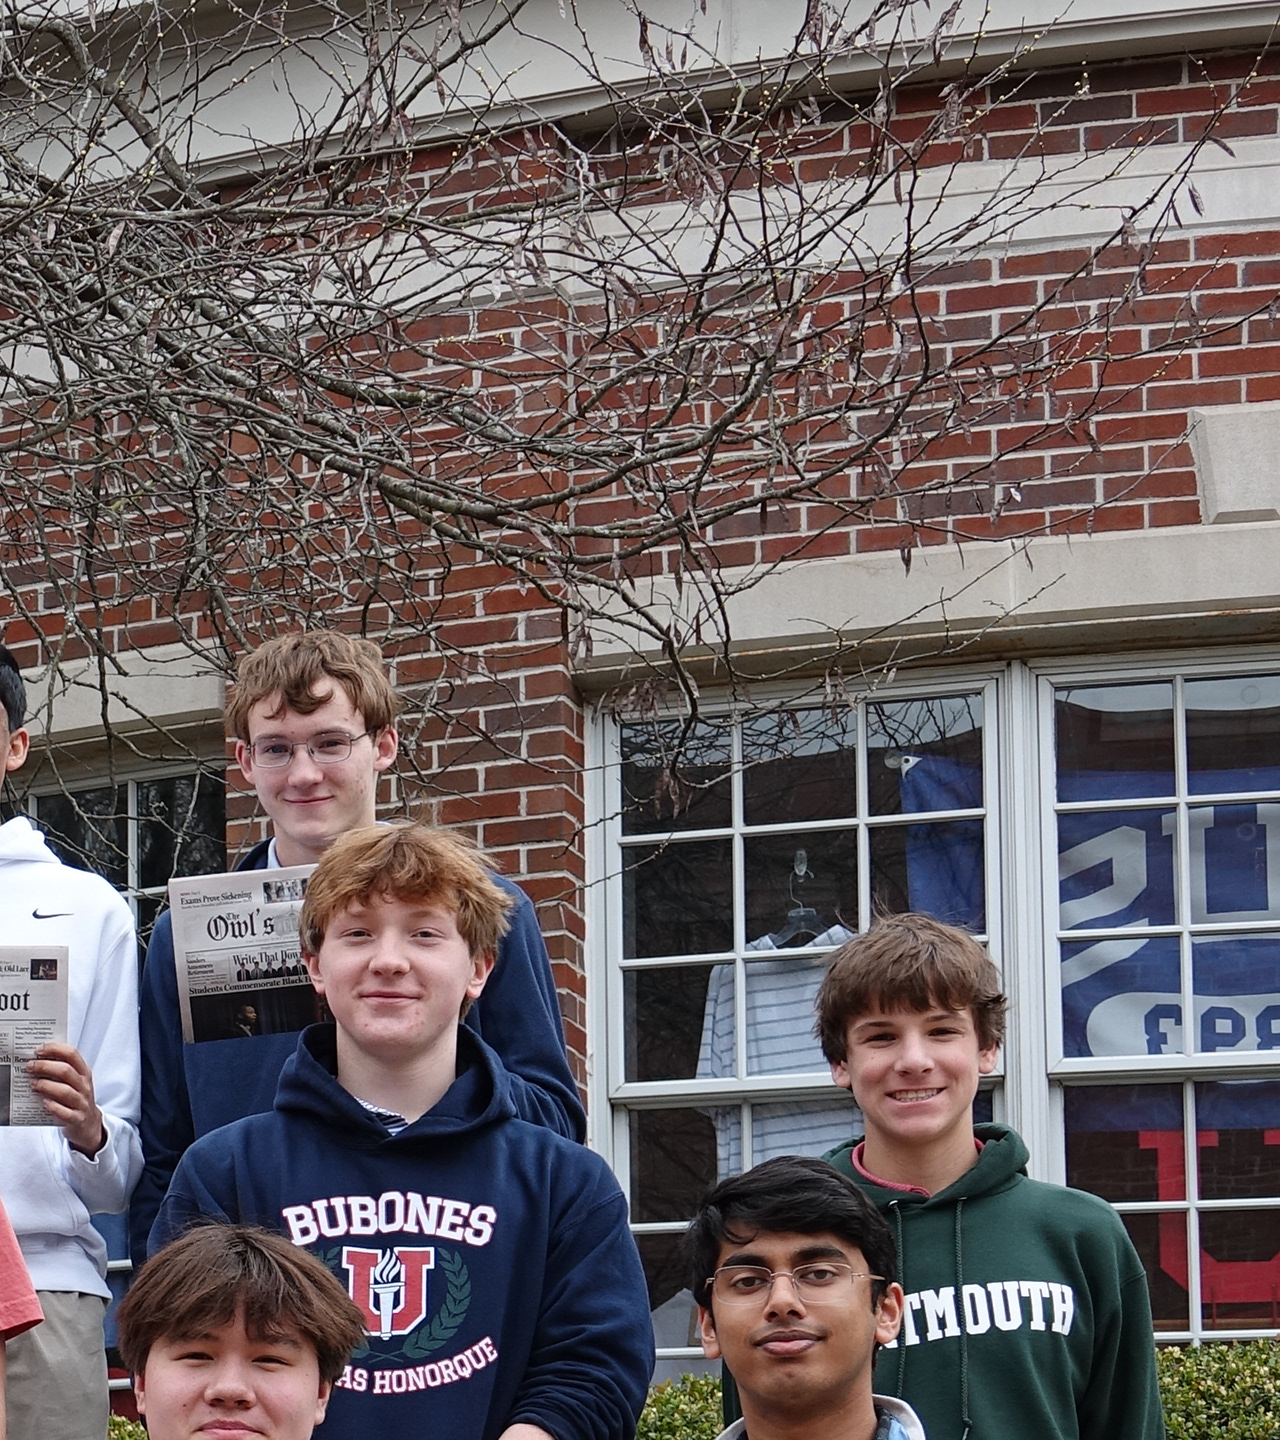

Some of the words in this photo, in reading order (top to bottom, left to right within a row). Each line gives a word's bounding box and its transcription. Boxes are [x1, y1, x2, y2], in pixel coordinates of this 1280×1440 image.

[282, 1191, 497, 1247] BUBONES
[880, 1281, 1075, 1349] TMOUTH
[373, 1336, 498, 1395] HONORQUE
